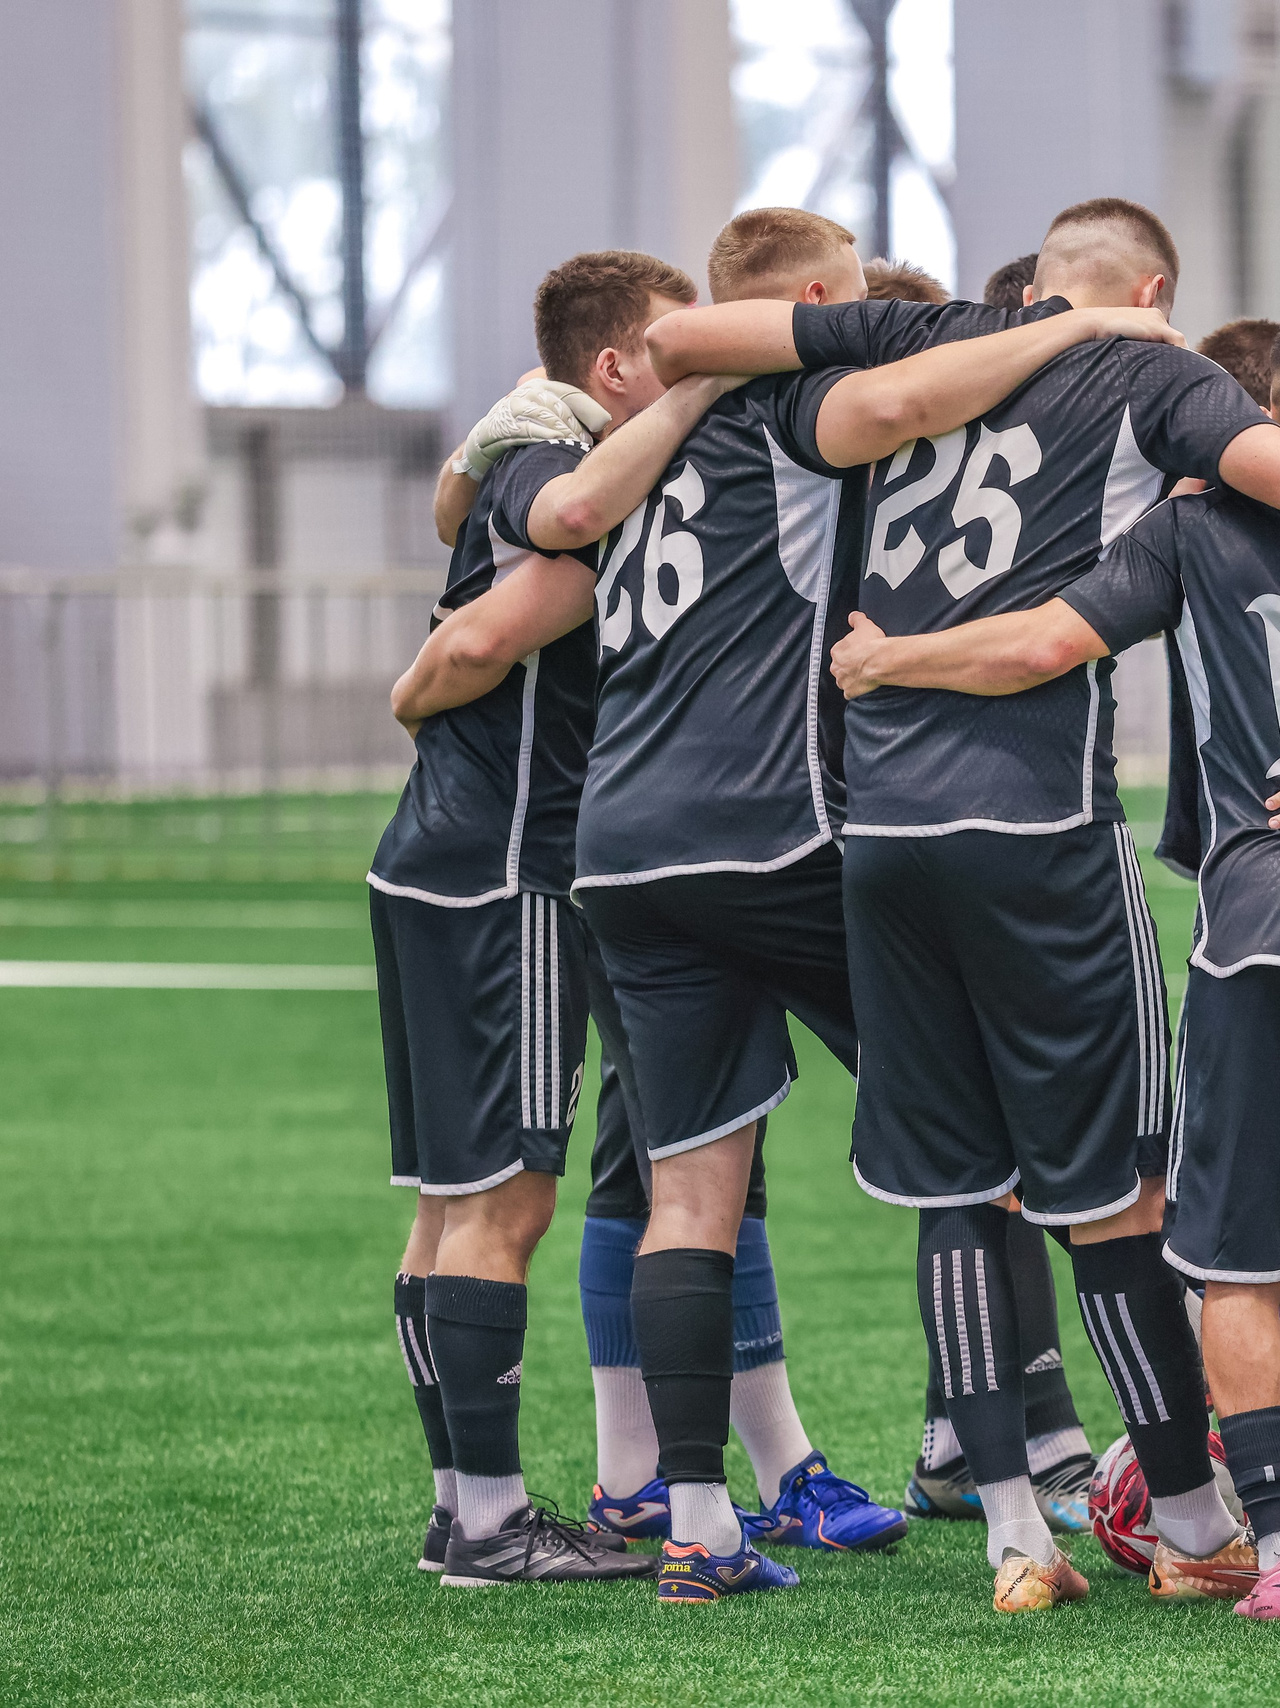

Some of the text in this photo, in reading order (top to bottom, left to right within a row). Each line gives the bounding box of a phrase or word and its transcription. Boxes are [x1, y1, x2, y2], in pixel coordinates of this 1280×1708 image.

[865, 422, 1044, 600] 25
[733, 1331, 782, 1350] oma
[1024, 1357, 1063, 1374] adida
[661, 1563, 692, 1574] joma
